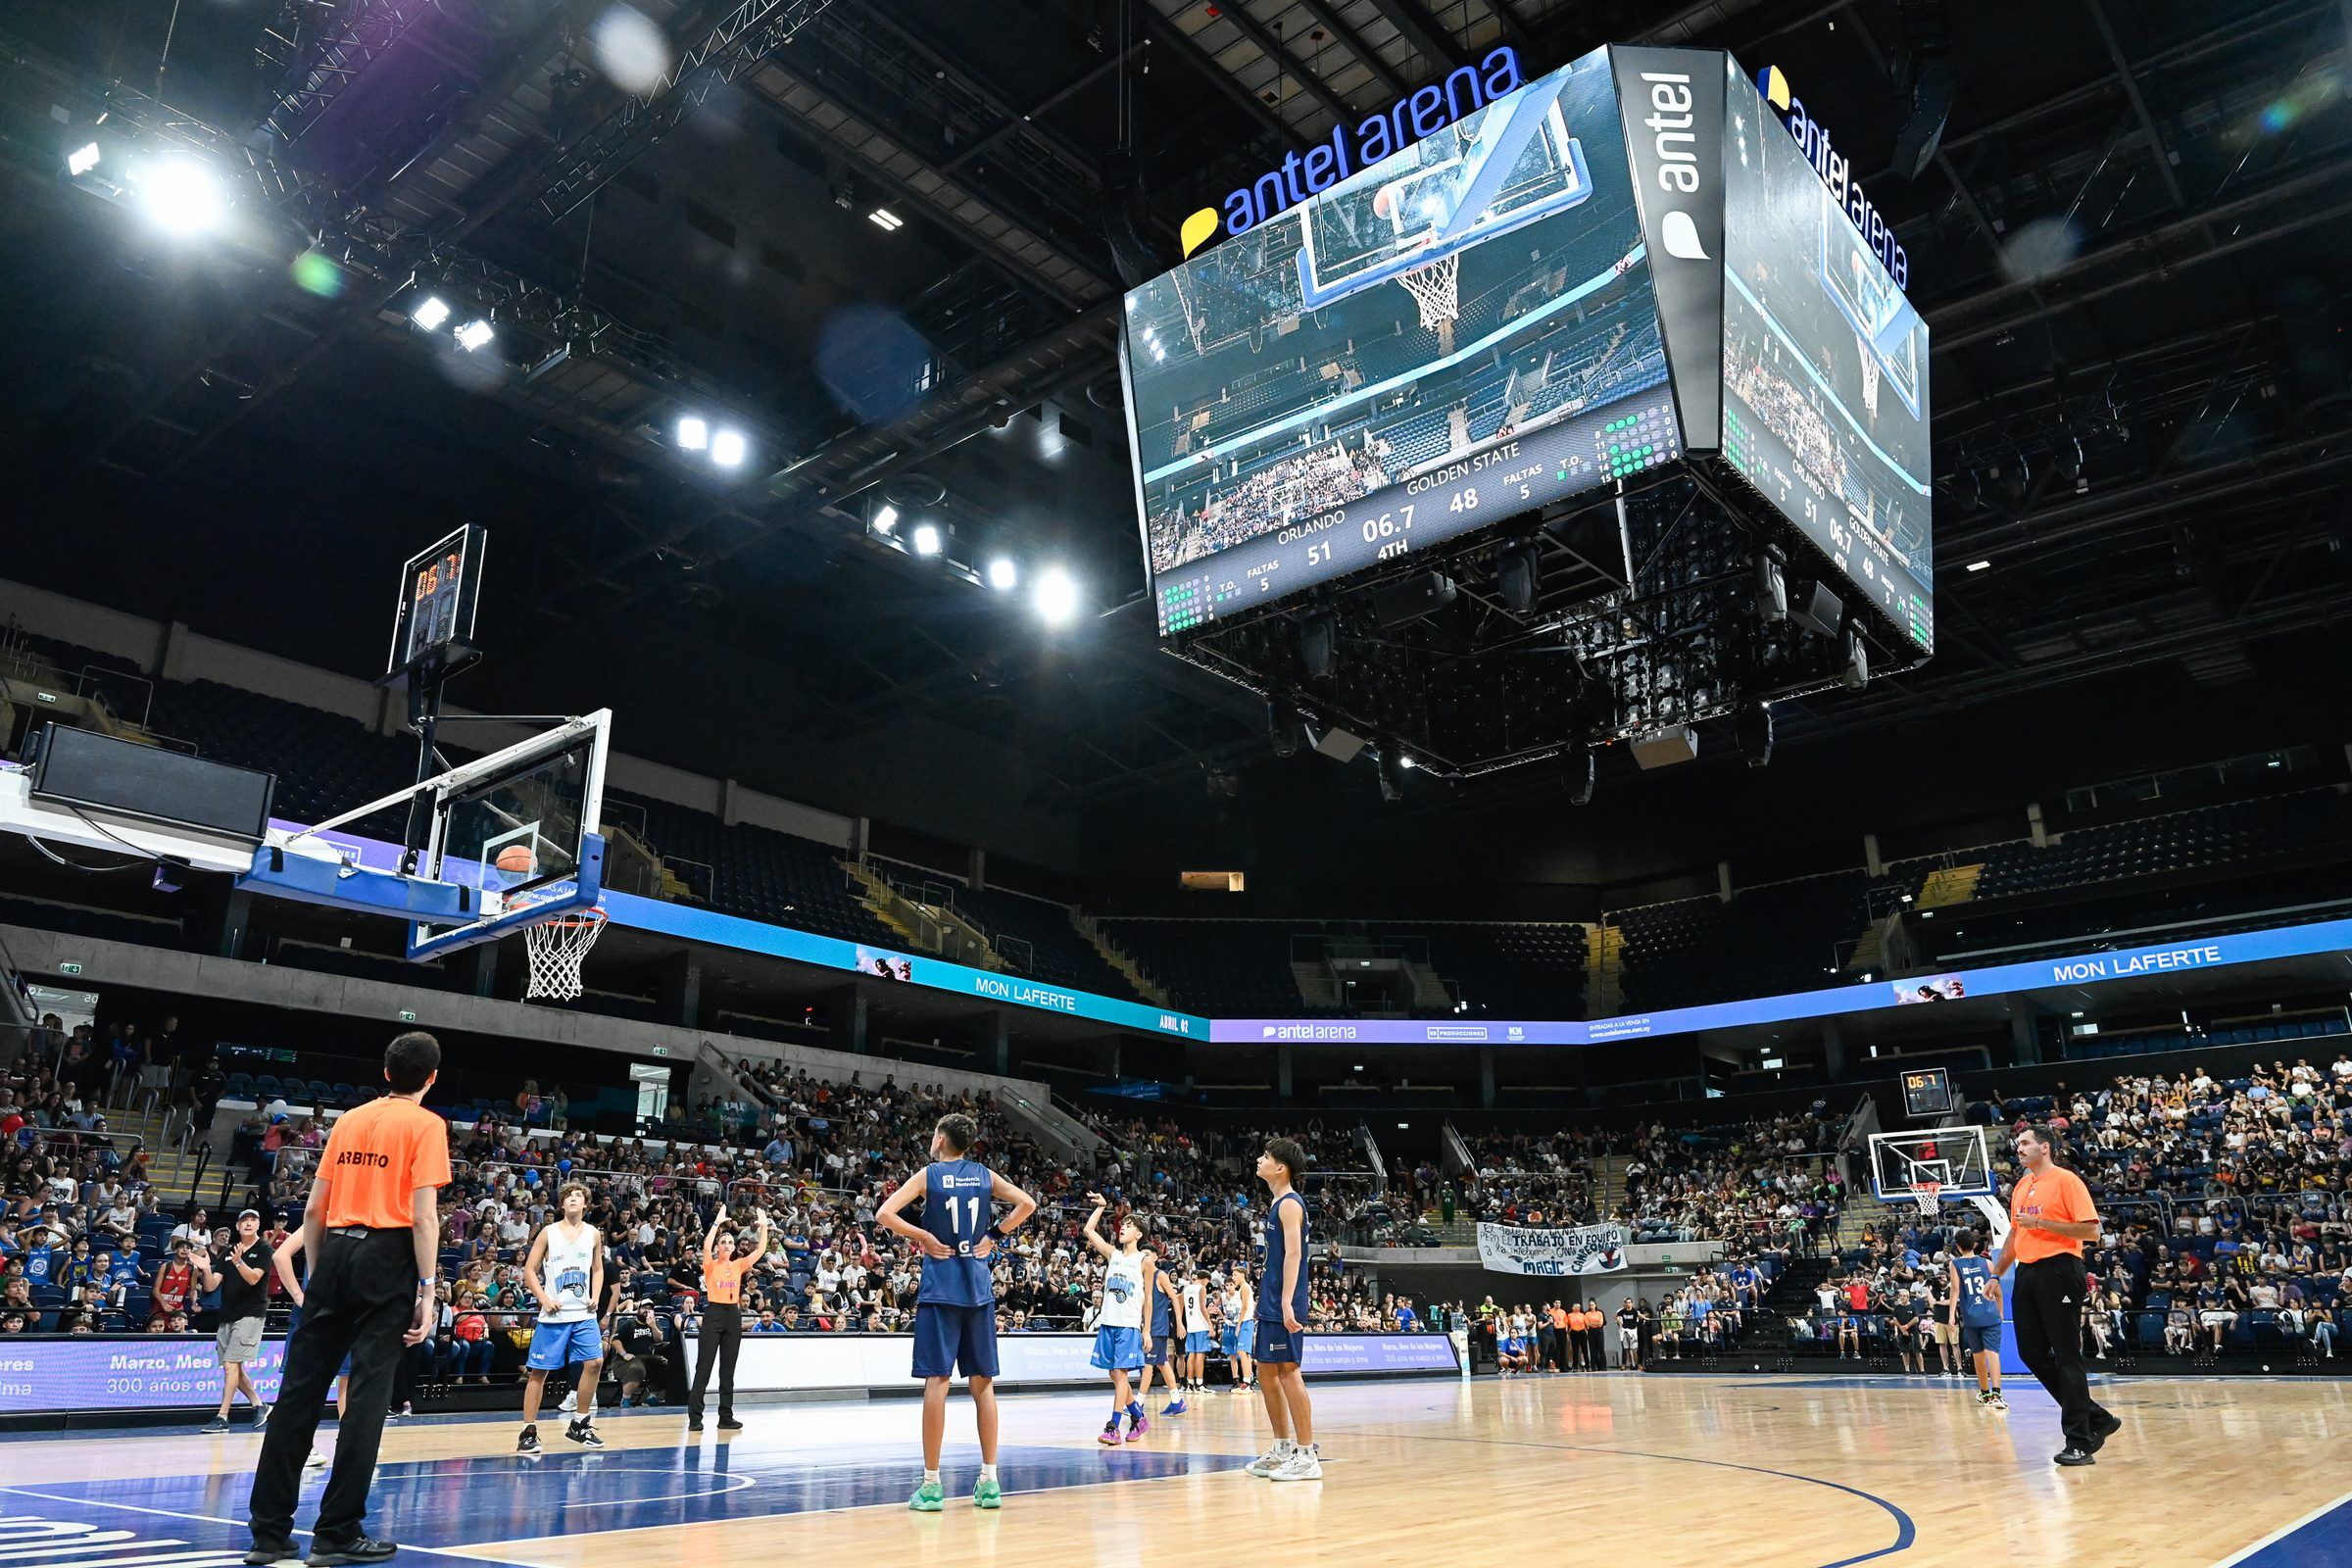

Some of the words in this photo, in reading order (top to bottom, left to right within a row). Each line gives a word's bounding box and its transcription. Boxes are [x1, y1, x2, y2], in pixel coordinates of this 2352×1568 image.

[1225, 124, 1348, 235] antel
[1356, 46, 1521, 165] arena
[1641, 73, 1700, 192] antel
[1790, 97, 1849, 210] antel
[1851, 181, 1908, 291] arena
[1407, 463, 1469, 495] GOLDEN
[1473, 442, 1521, 472] STATE
[1560, 456, 1584, 470] T.O.
[1503, 464, 1544, 486] FALTAS
[1792, 460, 1825, 500] ORLANDO
[1449, 487, 1479, 514] 48
[1520, 484, 1531, 501] 5
[1780, 488, 1786, 502] 5
[1804, 497, 1817, 523] 51
[1278, 510, 1346, 545] ORLANDO
[1362, 504, 1416, 543] 06.7
[1830, 517, 1852, 554] 06.7
[1848, 515, 1872, 551] GOLDEN
[1872, 537, 1889, 566] STATE
[1307, 541, 1331, 566] 51
[1378, 539, 1408, 561] 4TH
[1247, 560, 1279, 578] FALTAS
[1862, 557, 1874, 580] 48
[1219, 581, 1237, 593] T.O.
[1260, 577, 1270, 591] 5
[2053, 961, 2105, 982] MON
[2113, 946, 2222, 974] LAFERTE
[976, 978, 1009, 997] MON
[1014, 985, 1076, 1010] LAFERTE
[1159, 1014, 1178, 1032] ABRIL
[1278, 1024, 1313, 1039] antel
[1315, 1026, 1356, 1039] arena
[1590, 1022, 1613, 1031] ENTRADAS
[945, 1196, 980, 1235] 11
[1513, 1235, 1564, 1247] TRABAJO
[1569, 1235, 1583, 1247] EN
[1586, 1230, 1617, 1245] EQUIPO
[1523, 1260, 1564, 1274] MAGIC
[1964, 1276, 1985, 1295] 13
[1188, 1297, 1195, 1309] 9
[110, 1354, 171, 1371] Marzo,
[176, 1354, 212, 1369] Mes
[107, 1378, 142, 1394] 300
[149, 1378, 190, 1392] años
[196, 1380, 217, 1391] en
